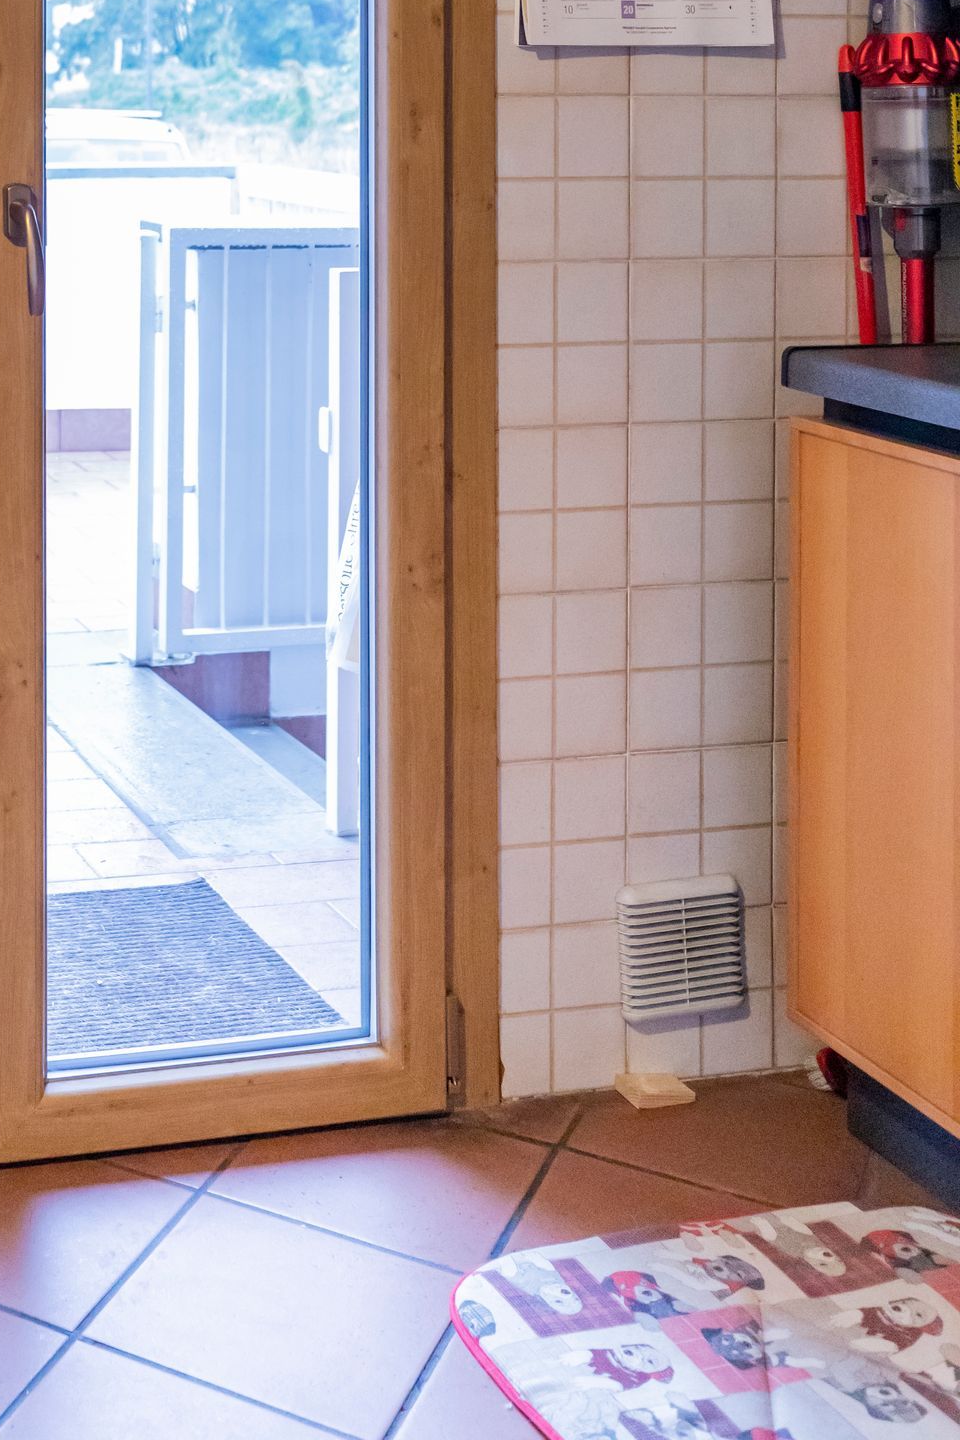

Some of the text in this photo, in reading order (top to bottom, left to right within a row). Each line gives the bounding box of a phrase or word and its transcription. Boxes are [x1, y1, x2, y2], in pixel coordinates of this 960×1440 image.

[564, 5, 573, 14] 10
[623, 5, 634, 15] 20
[686, 5, 695, 14] 30
